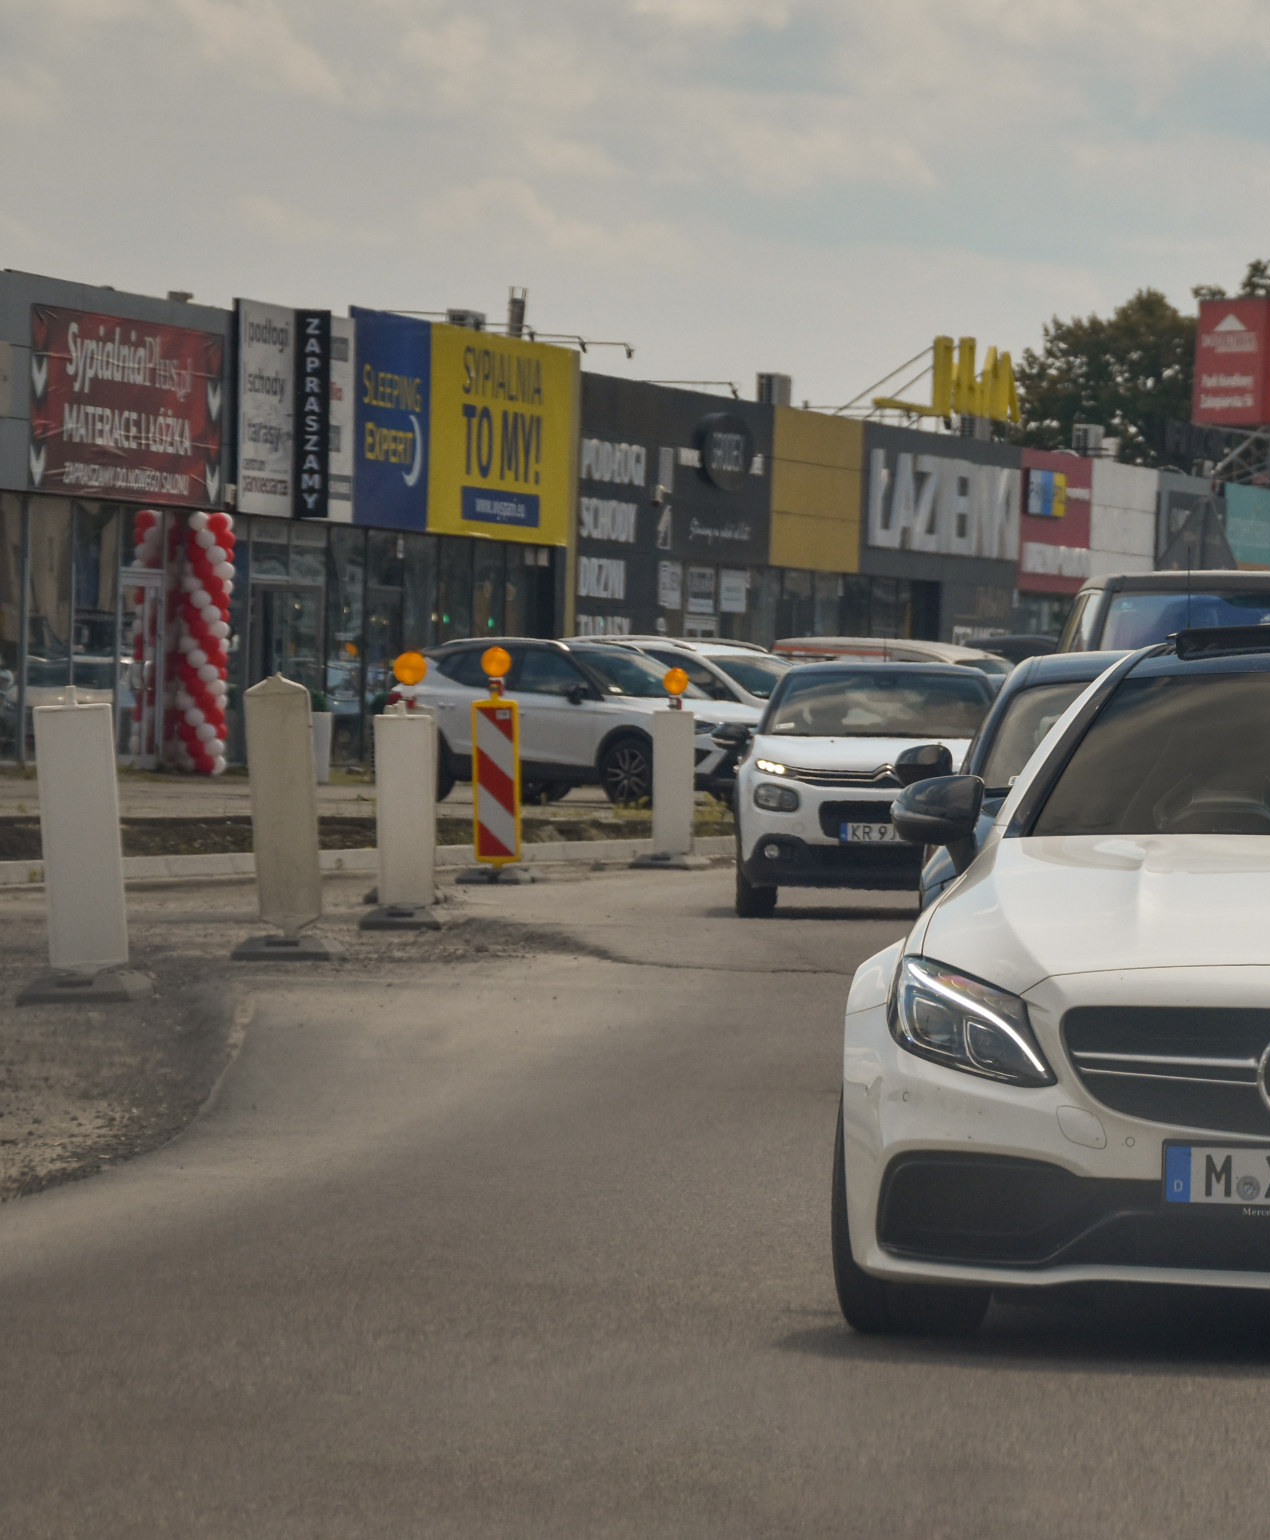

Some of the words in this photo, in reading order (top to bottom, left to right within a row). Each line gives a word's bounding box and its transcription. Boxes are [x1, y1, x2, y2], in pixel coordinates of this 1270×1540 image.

[363, 363, 421, 413] SLEEPING
[463, 345, 543, 405] SYPIALNIA
[63, 402, 139, 450] MATERACE
[300, 317, 321, 510] ZAPRASZAMY
[365, 421, 415, 465] EXPERT
[463, 403, 493, 479] TO
[501, 409, 543, 485] MY!
[581, 438, 647, 487] PODŁOGI
[580, 496, 637, 543] SCHODY
[851, 825, 872, 840] KR
[1173, 1179, 1183, 1193] D
[1205, 1154, 1232, 1197] M
